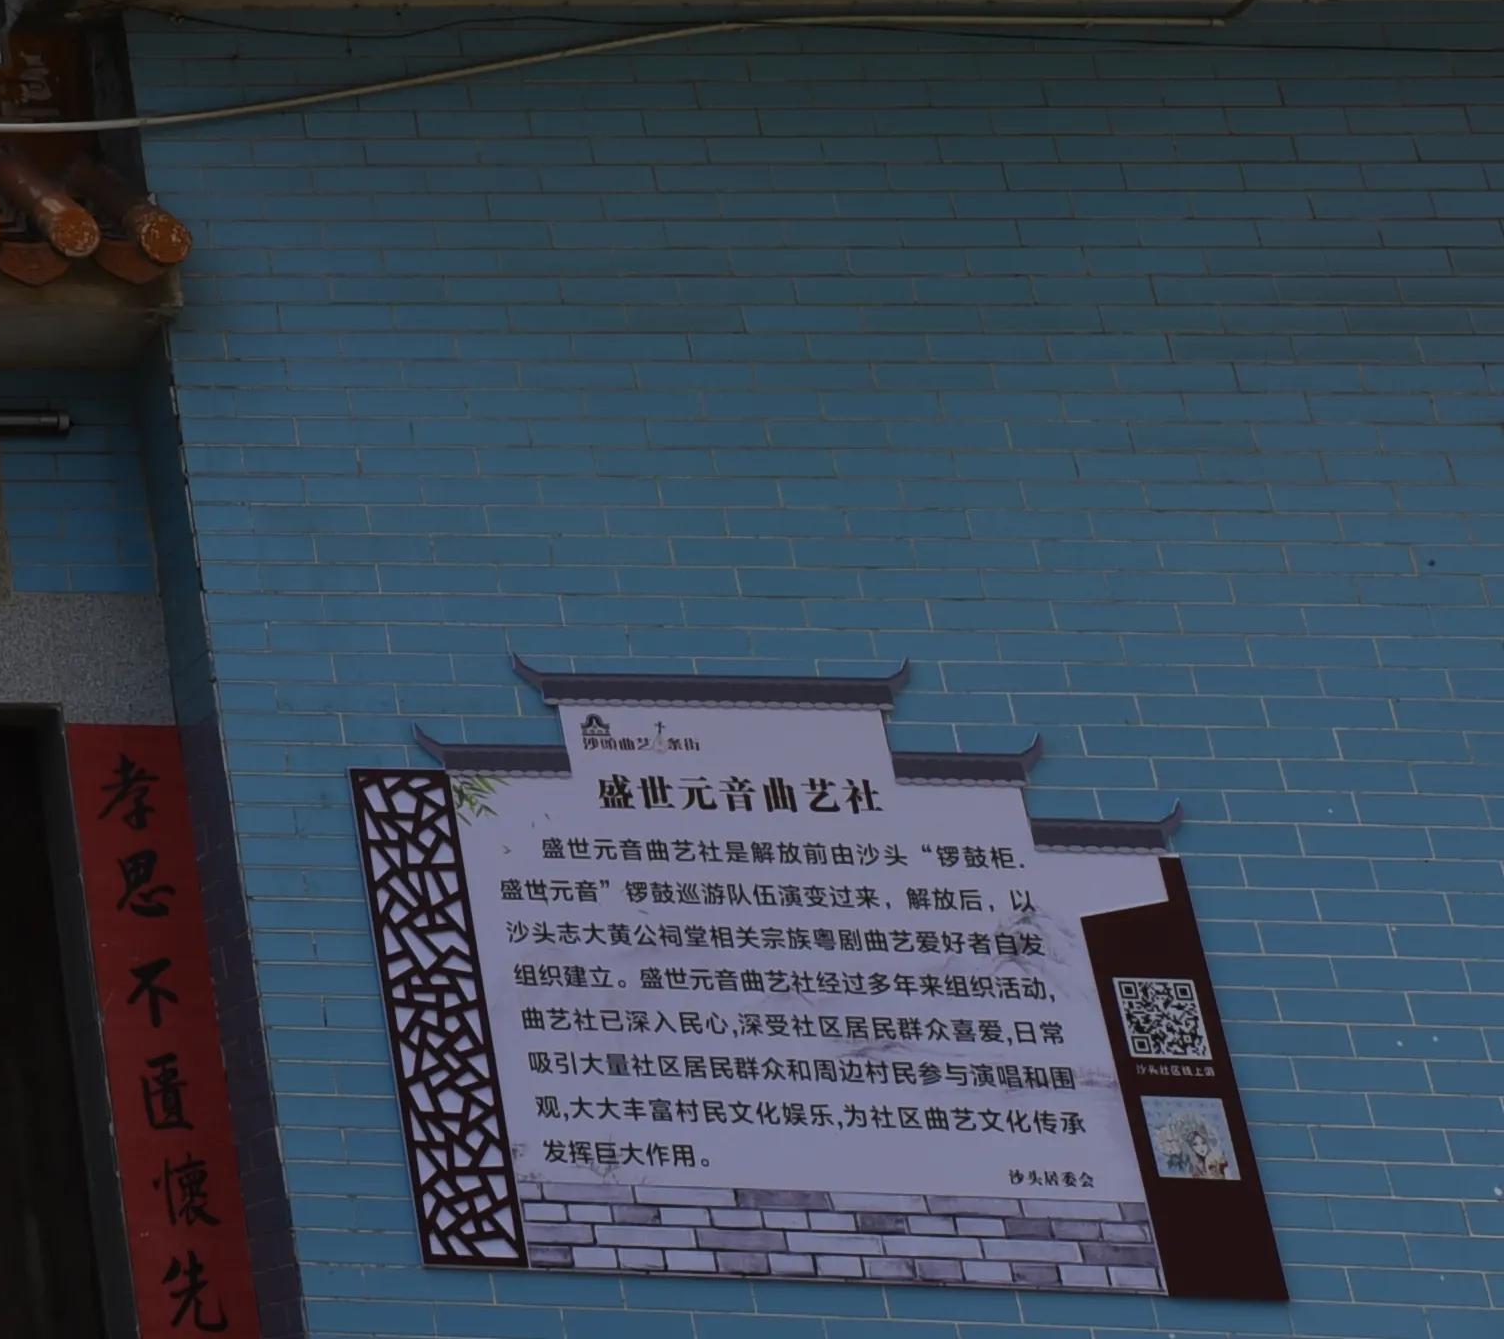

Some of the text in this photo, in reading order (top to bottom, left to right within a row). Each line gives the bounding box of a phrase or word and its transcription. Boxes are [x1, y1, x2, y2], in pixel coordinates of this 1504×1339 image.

[598, 774, 884, 814] 盛世元音曲艺社
[505, 921, 1046, 956] 沙头志大黄公祠堂相关宗族粤剧曲艺爱好者自发
[528, 1052, 1076, 1090] 吸引大量社区居民群众和周边村民参与演唱和围
[543, 1140, 711, 1168] 发挥巨大作用。
